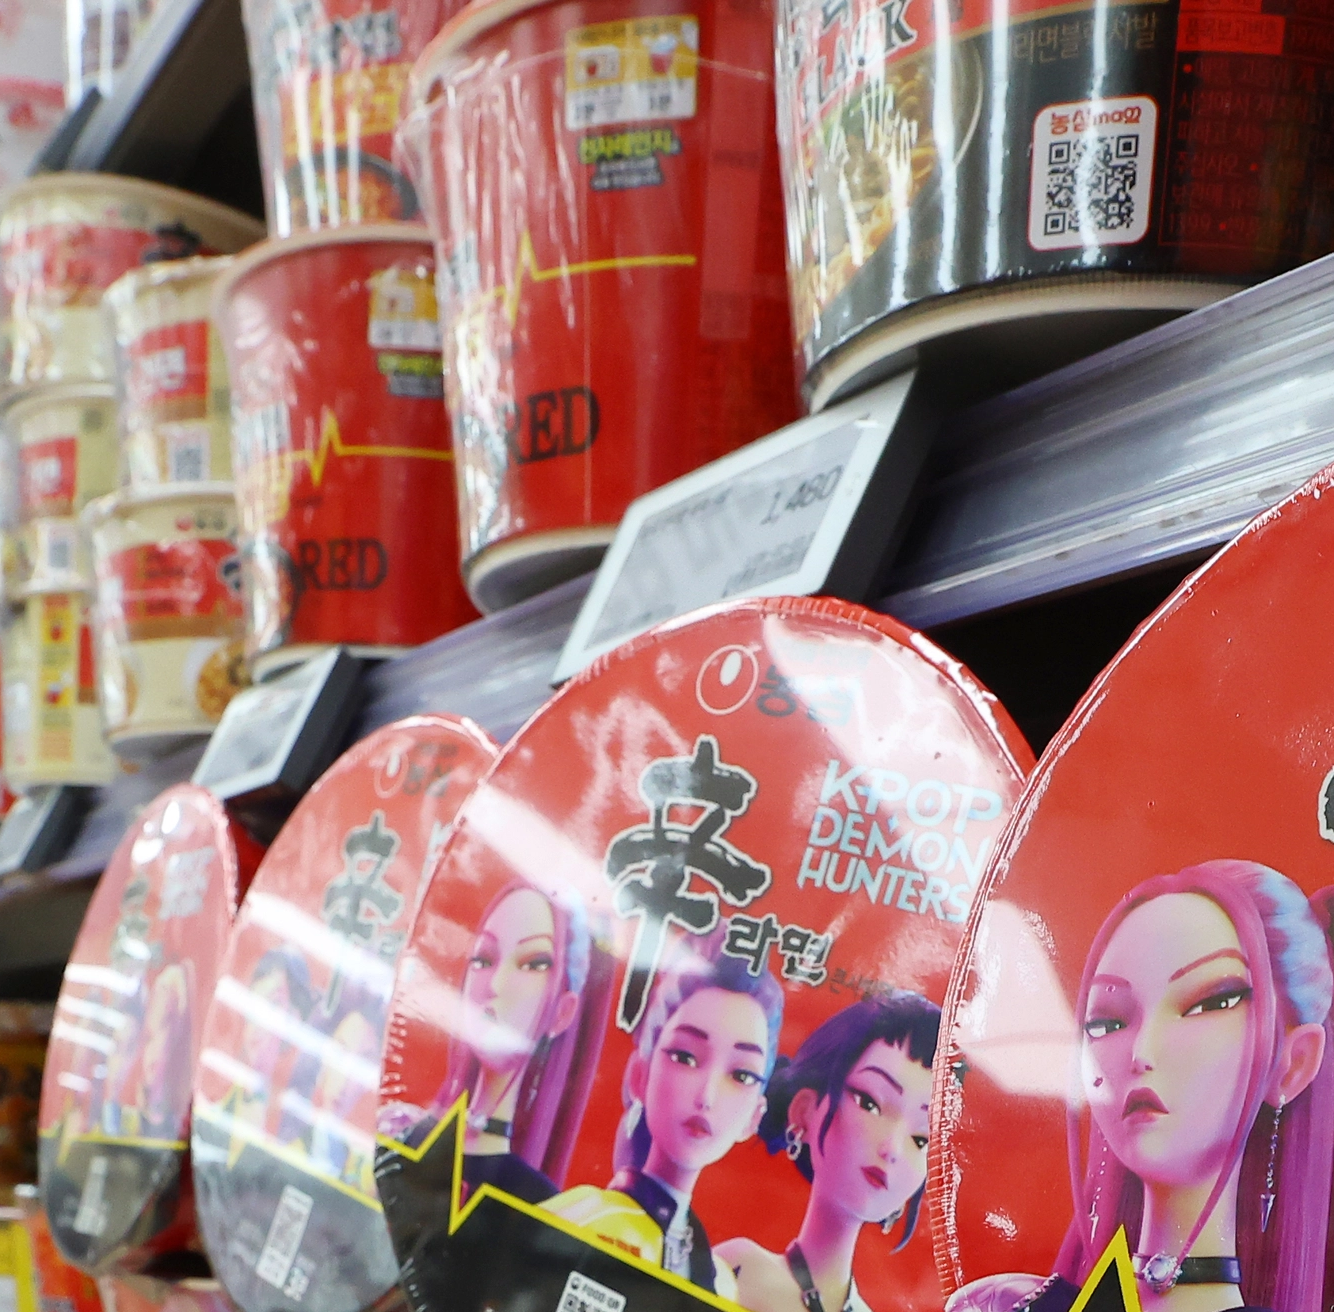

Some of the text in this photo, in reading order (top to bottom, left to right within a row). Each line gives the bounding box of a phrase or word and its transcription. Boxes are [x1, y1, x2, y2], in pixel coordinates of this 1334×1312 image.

[505, 386, 600, 464] RED
[297, 537, 389, 592] RED
[604, 734, 772, 1032] 辛
[808, 812, 992, 883] DEMON
[798, 848, 971, 924] HUNTERS
[720, 916, 833, 986] 라면
